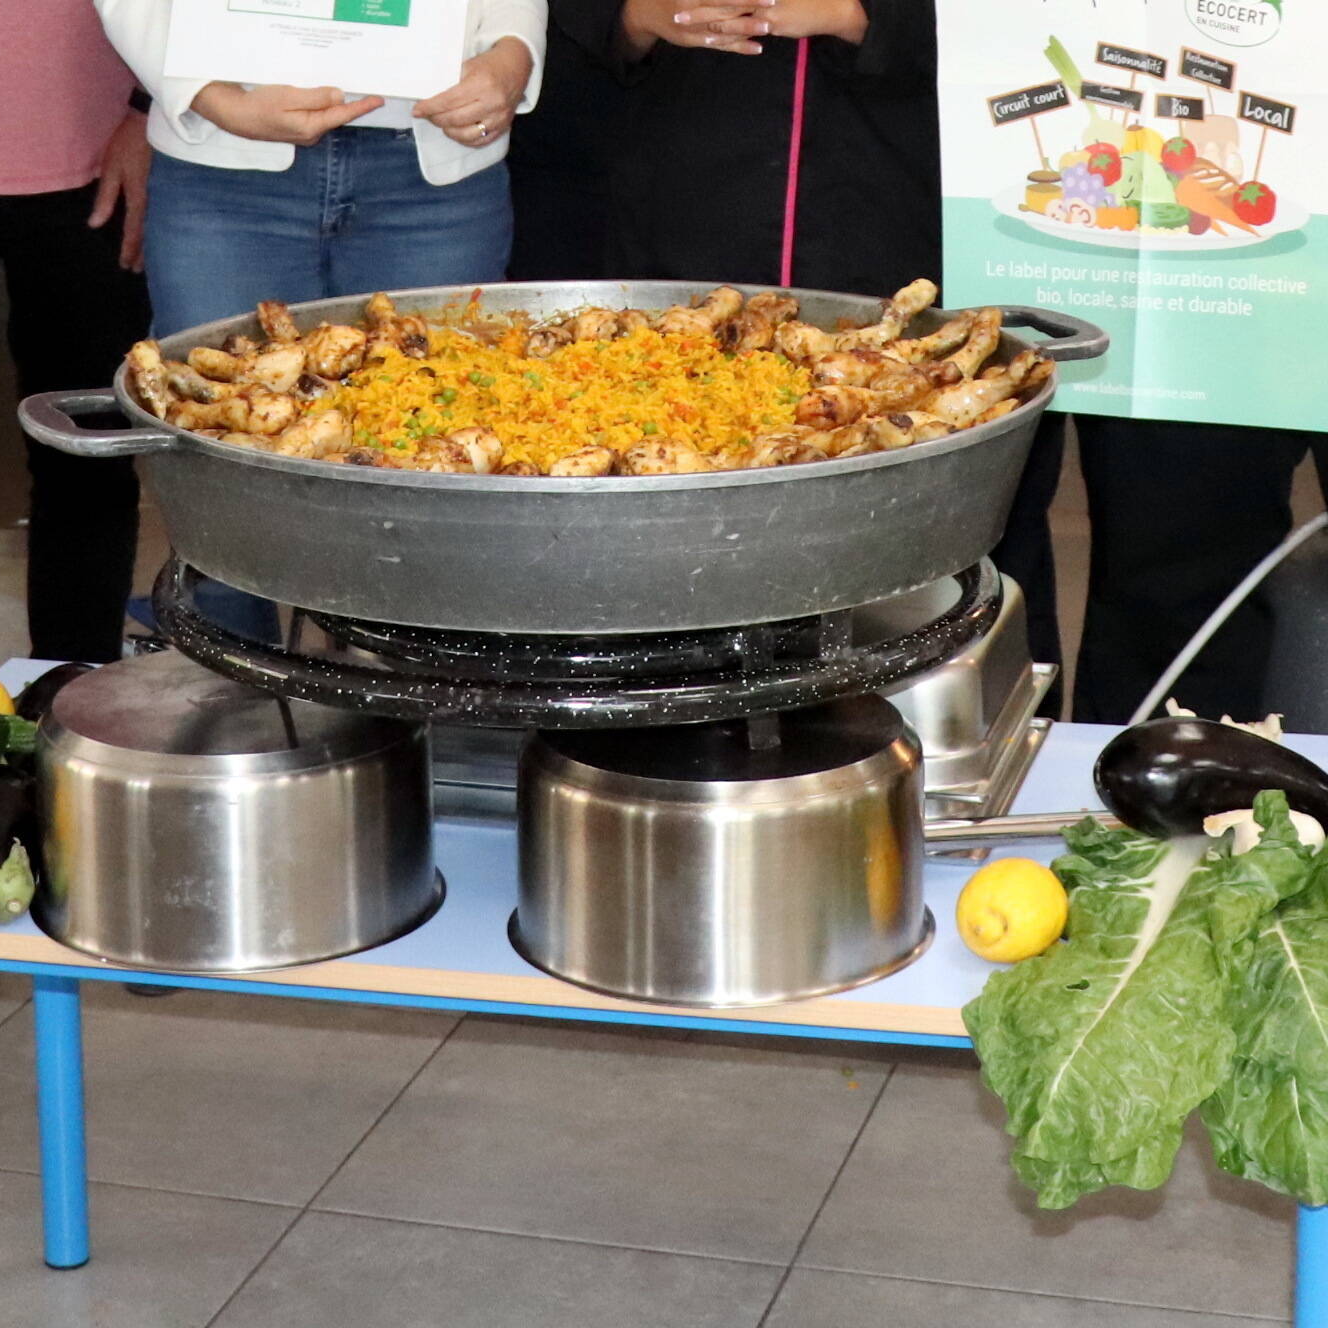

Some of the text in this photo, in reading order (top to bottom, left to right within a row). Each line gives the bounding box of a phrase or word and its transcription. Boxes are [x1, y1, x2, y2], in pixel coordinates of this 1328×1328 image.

[1196, 16, 1241, 33] EN CUISINE
[1103, 47, 1163, 74] Saisonnalité
[993, 93, 1031, 118] Circuit
[1033, 84, 1065, 105] court
[1172, 97, 1190, 118] Bio
[1244, 96, 1291, 129] Local
[986, 261, 1006, 277] Le
[1009, 261, 1047, 279] label
[1051, 267, 1088, 283] pour
[1092, 269, 1119, 283] une
[1228, 274, 1307, 295] collective
[1035, 286, 1065, 305] bio,
[1069, 288, 1118, 309] locale,
[1167, 296, 1185, 312] et
[1188, 295, 1253, 316] durable
